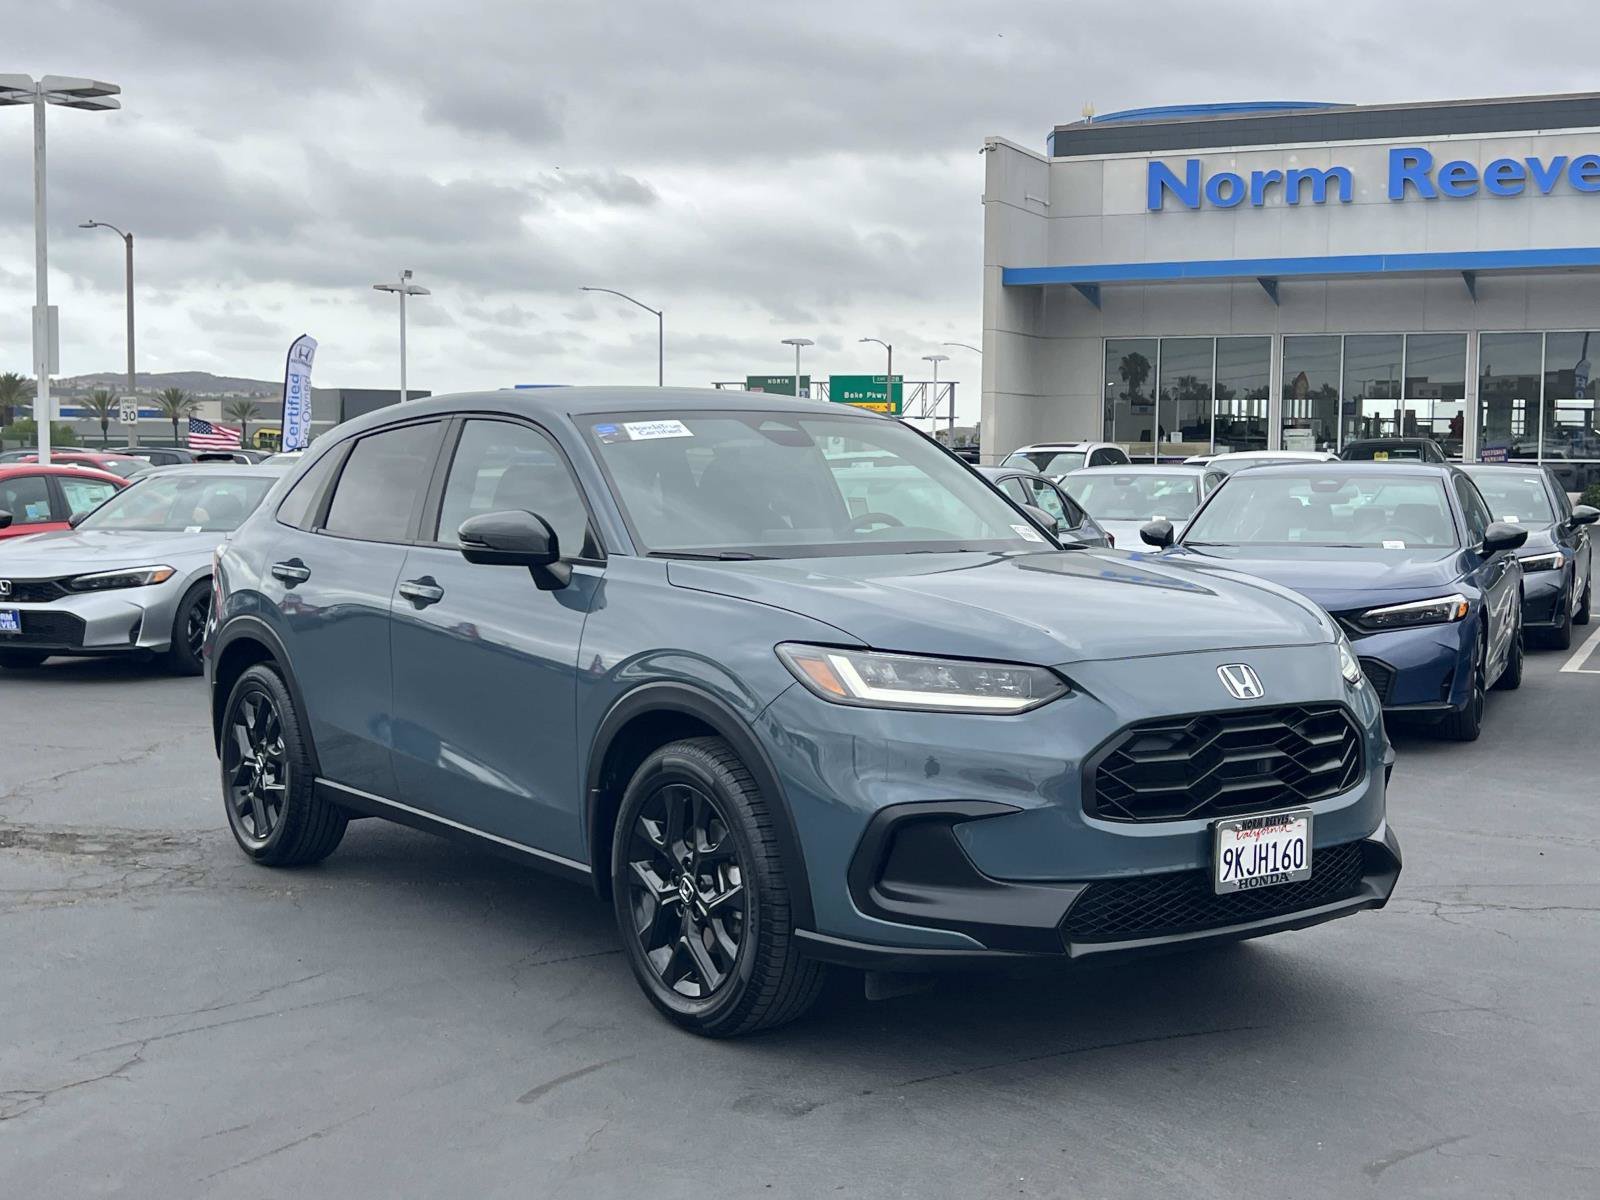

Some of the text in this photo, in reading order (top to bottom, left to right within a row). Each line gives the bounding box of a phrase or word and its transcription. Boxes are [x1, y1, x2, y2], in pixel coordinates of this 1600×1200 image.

[1147, 147, 1600, 211] Norm Reeve
[844, 391, 887, 400] Bake Pkwy
[122, 410, 136, 421] 30
[286, 373, 300, 448] Certified
[1236, 822, 1292, 842] California
[1223, 838, 1304, 880] 9KJH160
[1238, 872, 1290, 889] HONDA
